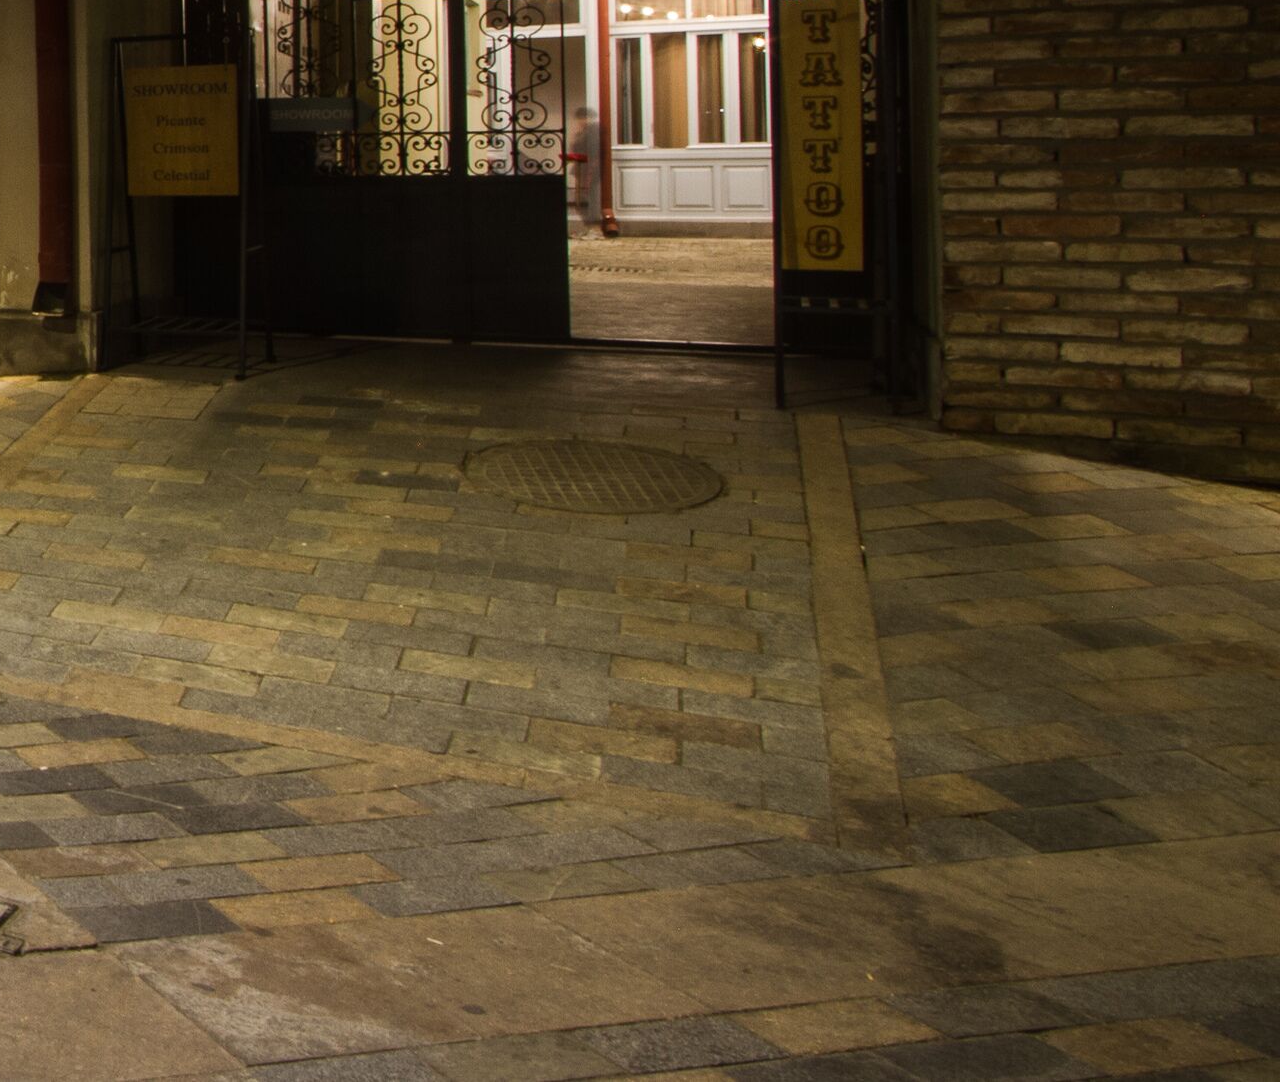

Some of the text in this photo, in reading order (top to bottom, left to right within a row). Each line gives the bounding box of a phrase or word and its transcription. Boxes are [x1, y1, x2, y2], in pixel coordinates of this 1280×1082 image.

[132, 81, 228, 97] SHOWROOM
[155, 114, 206, 127] Picante
[271, 108, 354, 120] SHOWROOM
[799, 8, 844, 261] TATTOO
[152, 141, 209, 154] Crimson
[153, 168, 210, 181] Celestial
